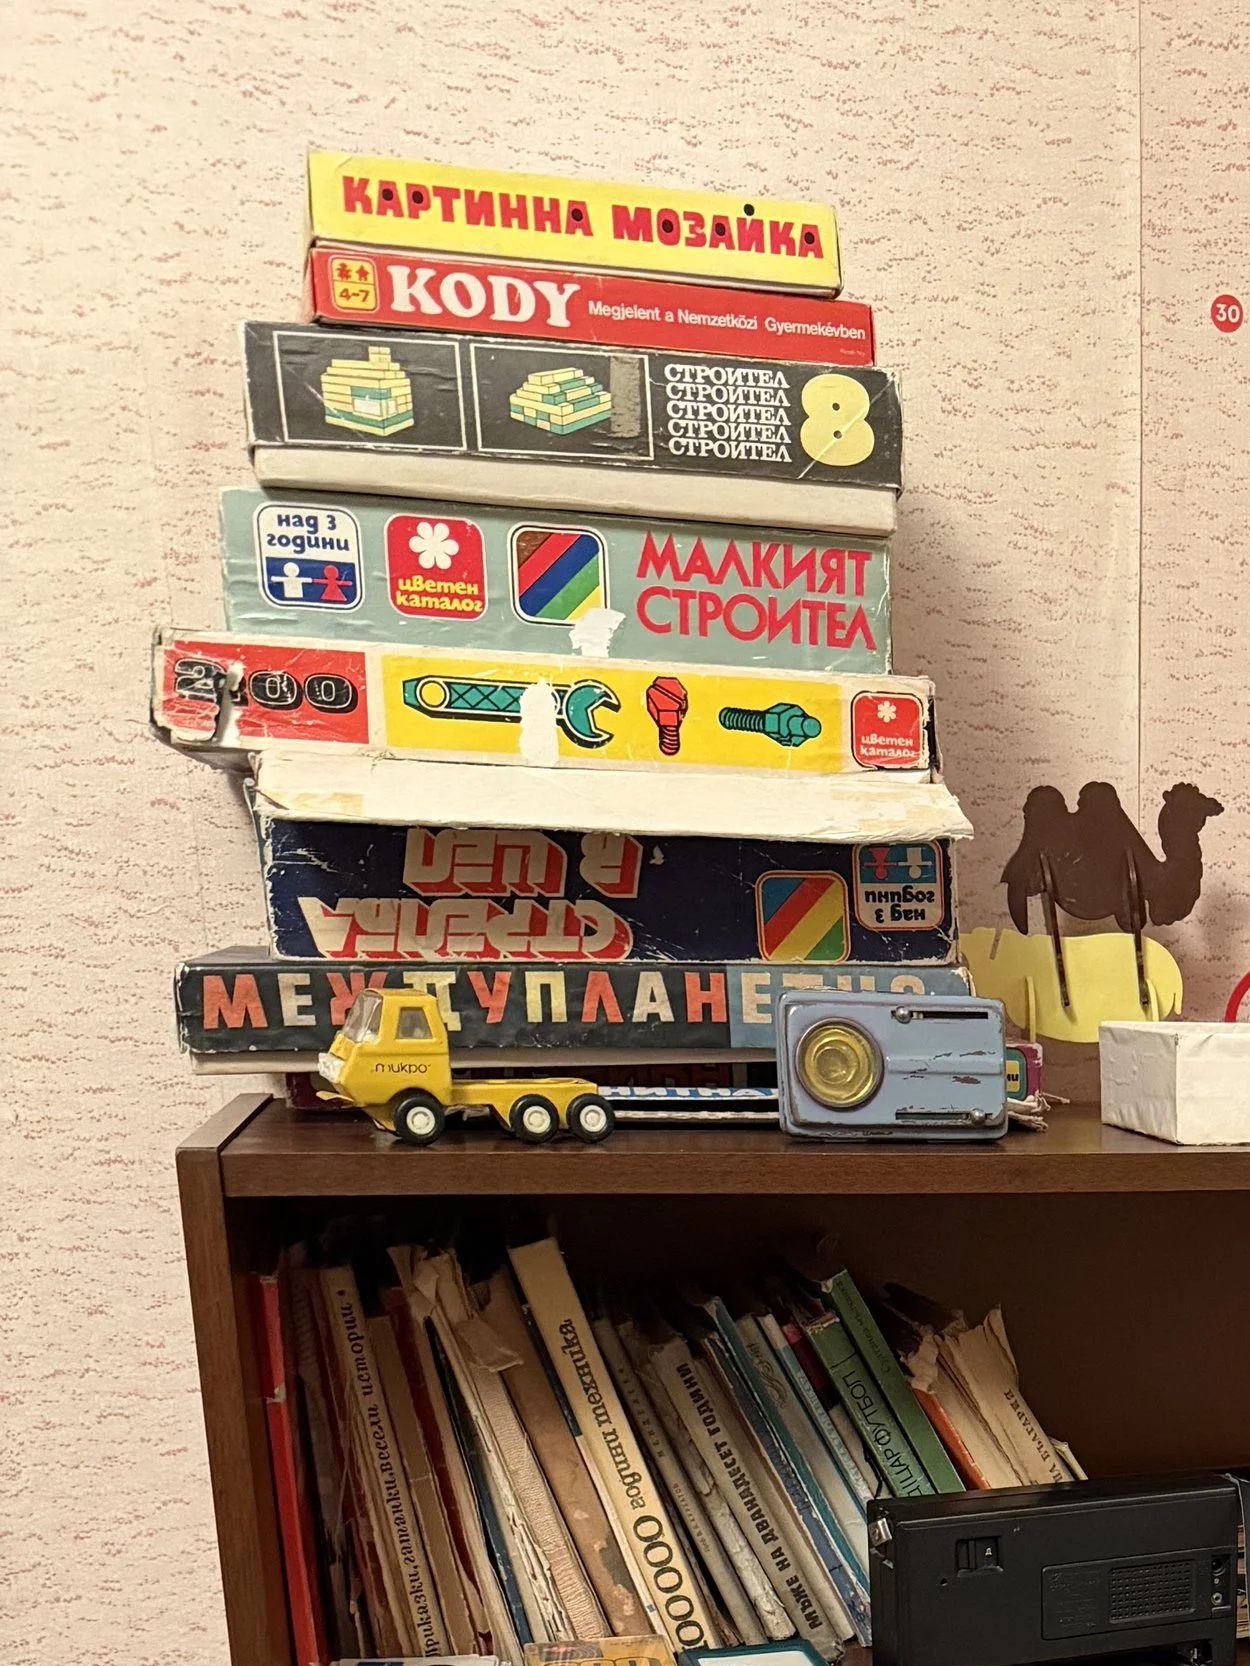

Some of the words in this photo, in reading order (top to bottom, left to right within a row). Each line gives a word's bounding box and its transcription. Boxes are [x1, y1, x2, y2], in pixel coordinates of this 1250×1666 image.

[342, 175, 594, 237] КАРТИННА
[611, 203, 824, 259] МОЗАЙКА
[338, 287, 371, 303] 4-7
[387, 264, 581, 329] KODY
[588, 300, 660, 322] Megjelent
[664, 311, 674, 322] a
[764, 317, 866, 341] Gyermekévben
[1215, 303, 1241, 323] 30
[664, 363, 791, 389] СТРОИТЕЛ
[666, 382, 791, 408] СТРОИТЕЛ
[666, 400, 793, 426] СТРОИТЕЛ
[800, 373, 875, 467] 8
[667, 418, 793, 444] СТРОИТЕЛ
[668, 436, 793, 463] СТРОИТЕЛ
[277, 513, 319, 535] над
[327, 513, 337, 531] 3
[266, 533, 350, 555] години
[636, 530, 873, 597] МАЛКИЯТ
[397, 574, 479, 595] цветен
[395, 590, 483, 613] каталог
[636, 585, 877, 651] СТРОИТЕЛ
[859, 745, 918, 759] каталог
[861, 733, 914, 747] цветен
[402, 828, 568, 897] ЦЕЛ
[578, 831, 644, 899] В
[864, 884, 935, 903] години
[874, 907, 885, 924] 3
[890, 903, 926, 921] над
[297, 896, 634, 962] СТРЕЛБА
[675, 1362, 721, 1438] ГОДИНИ
[842, 1373, 892, 1447] ФУТБОЛ
[1003, 1389, 1051, 1464] БЪЛГАРИЯ
[713, 1441, 779, 1542] ДВАНАДЕСЕТ
[769, 1541, 791, 1571] НА
[785, 1575, 823, 1631] МЪЖЕ
